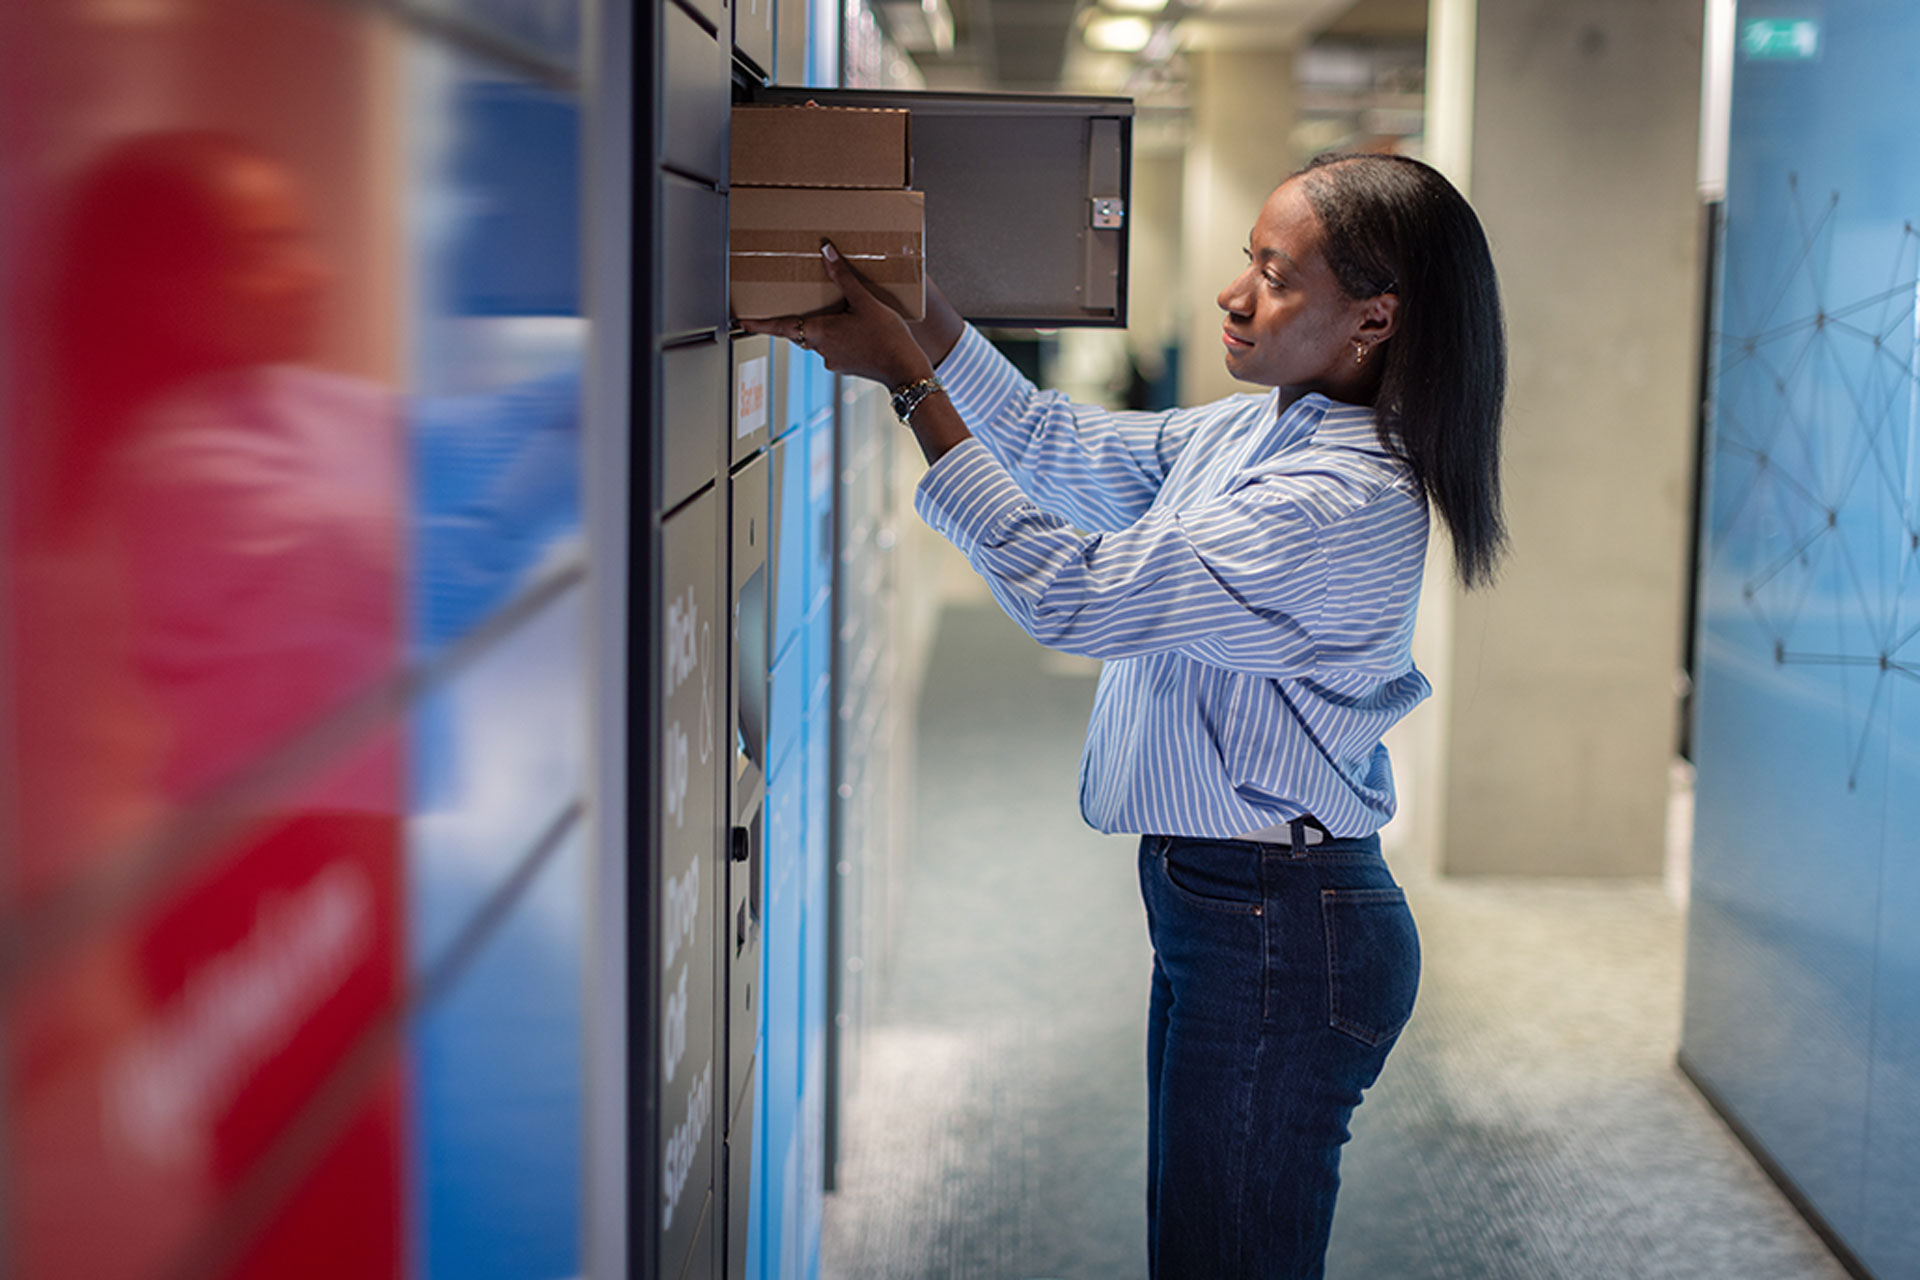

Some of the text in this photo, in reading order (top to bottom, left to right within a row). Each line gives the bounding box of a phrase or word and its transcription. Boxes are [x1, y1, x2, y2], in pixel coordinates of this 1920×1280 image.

[666, 720, 688, 829] Up
[665, 854, 699, 970] Drop
[664, 963, 688, 1083] Off
[663, 1060, 710, 1231] Station
